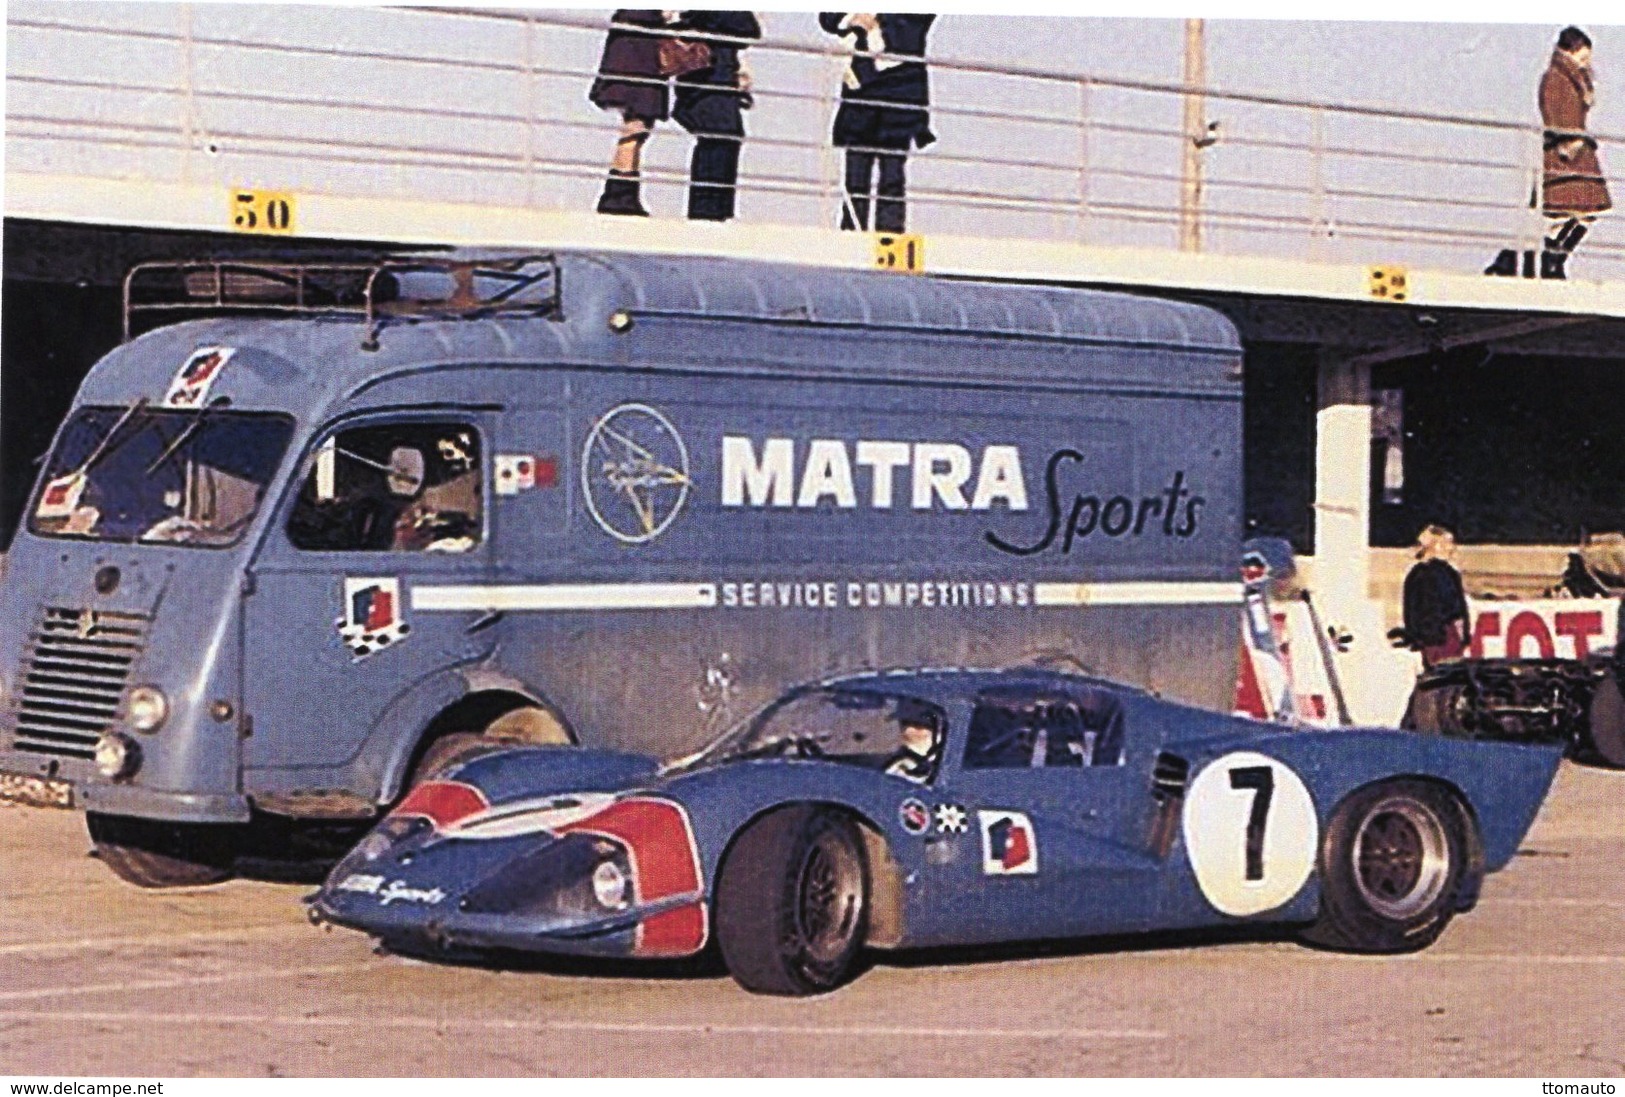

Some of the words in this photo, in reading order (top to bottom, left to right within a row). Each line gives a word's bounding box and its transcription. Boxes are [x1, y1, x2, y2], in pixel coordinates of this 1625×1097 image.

[235, 194, 289, 229] 50
[877, 237, 915, 270] 51
[721, 436, 1028, 510] MATRA
[986, 449, 1206, 554] Sports
[722, 582, 838, 607] SERVICE
[847, 582, 1029, 607] COMPETITIONS
[1228, 765, 1274, 881] 7
